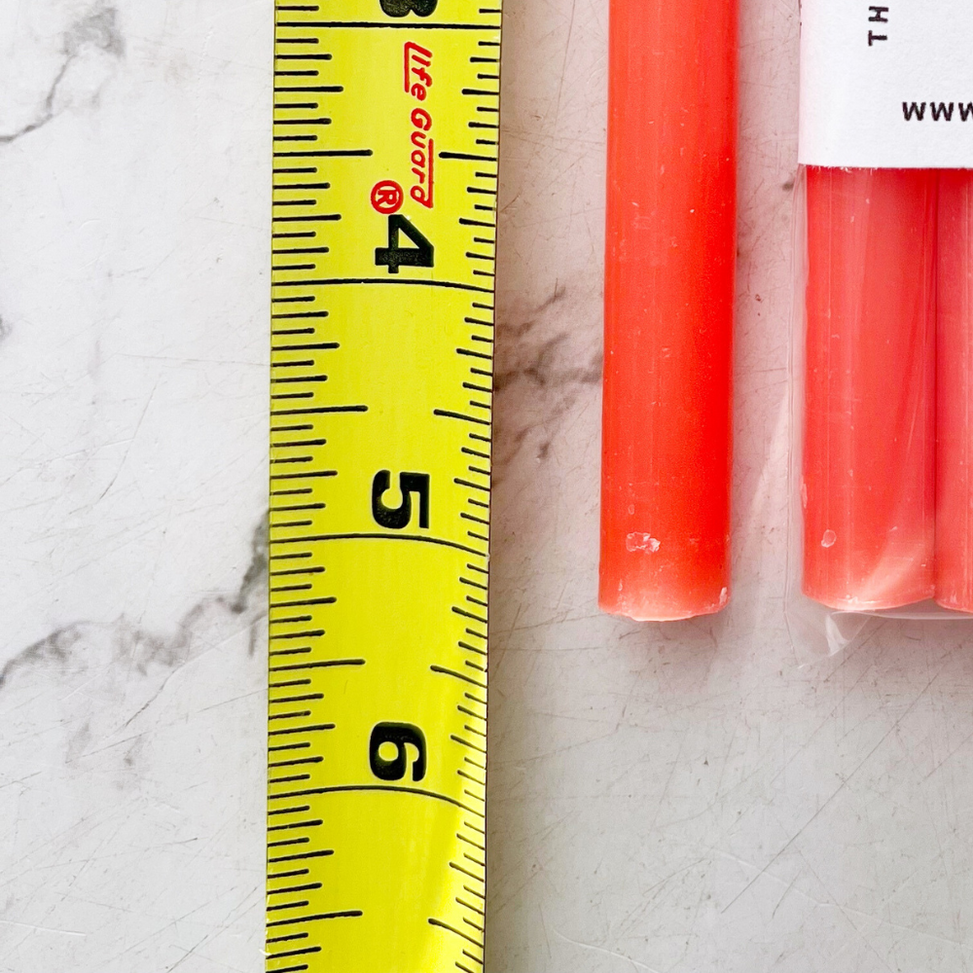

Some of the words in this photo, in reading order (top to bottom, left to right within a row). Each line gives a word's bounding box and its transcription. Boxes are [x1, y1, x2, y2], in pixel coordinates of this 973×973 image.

[374, 213, 435, 275] 4
[372, 468, 430, 530] 5
[368, 721, 427, 783] 6
